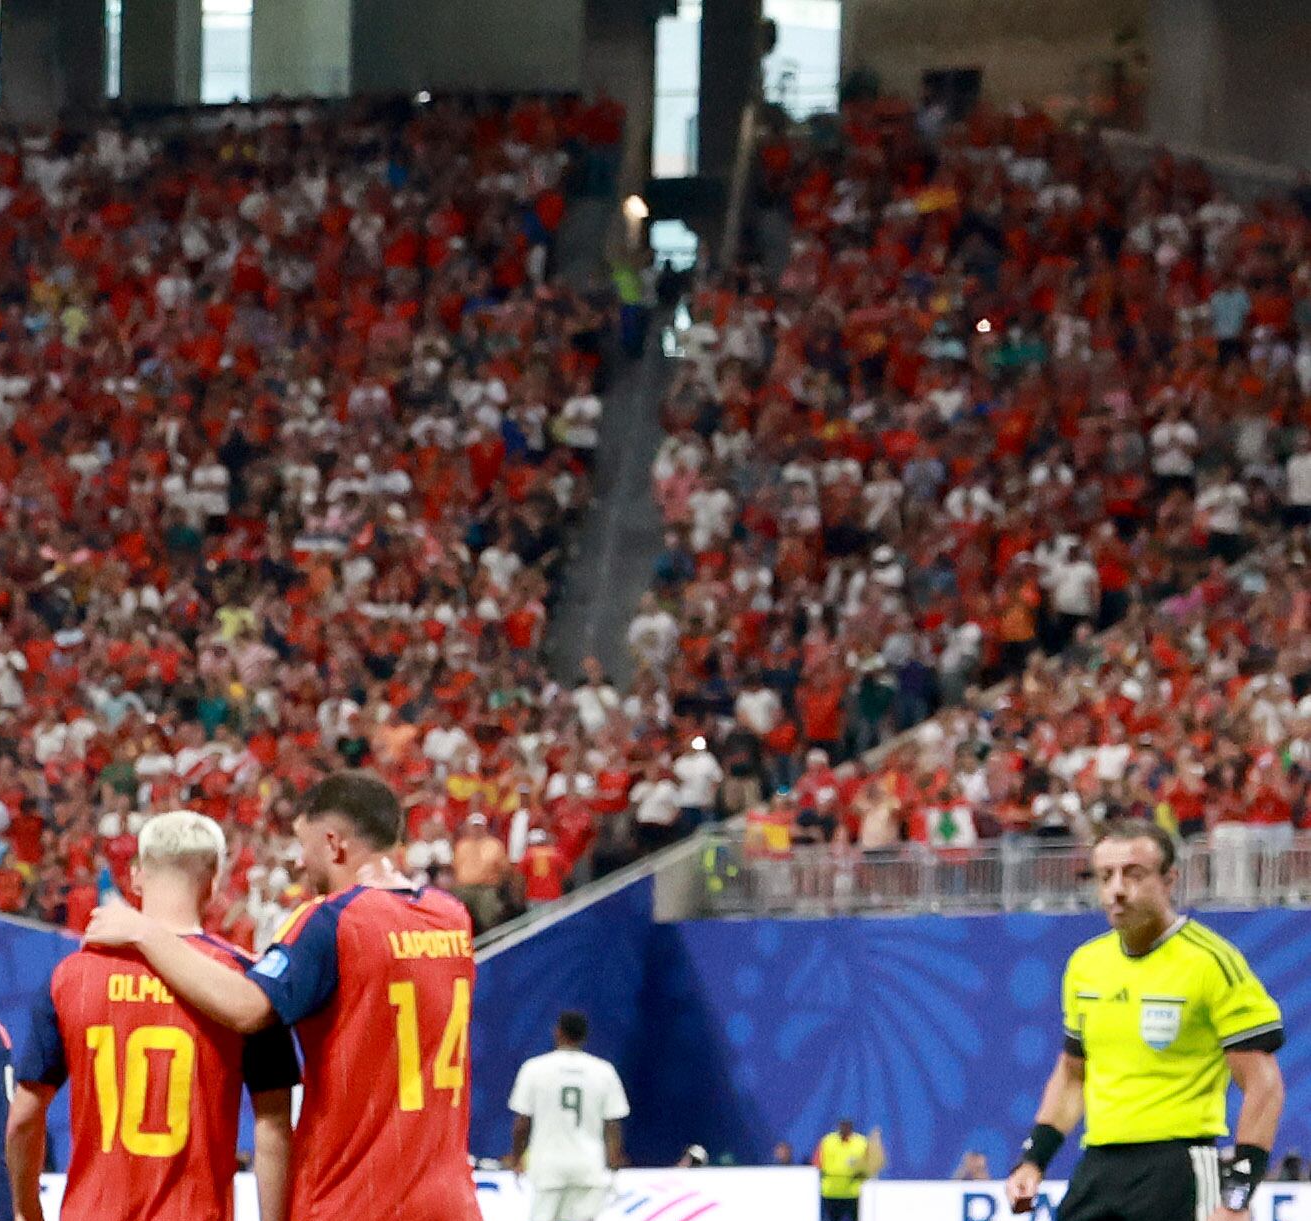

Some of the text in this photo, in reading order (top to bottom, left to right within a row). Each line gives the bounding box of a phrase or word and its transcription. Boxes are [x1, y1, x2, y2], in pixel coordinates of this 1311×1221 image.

[388, 929, 473, 960] LAPORTE
[388, 977, 470, 1111] 14
[86, 1025, 195, 1157] 10
[562, 1086, 582, 1128] 9
